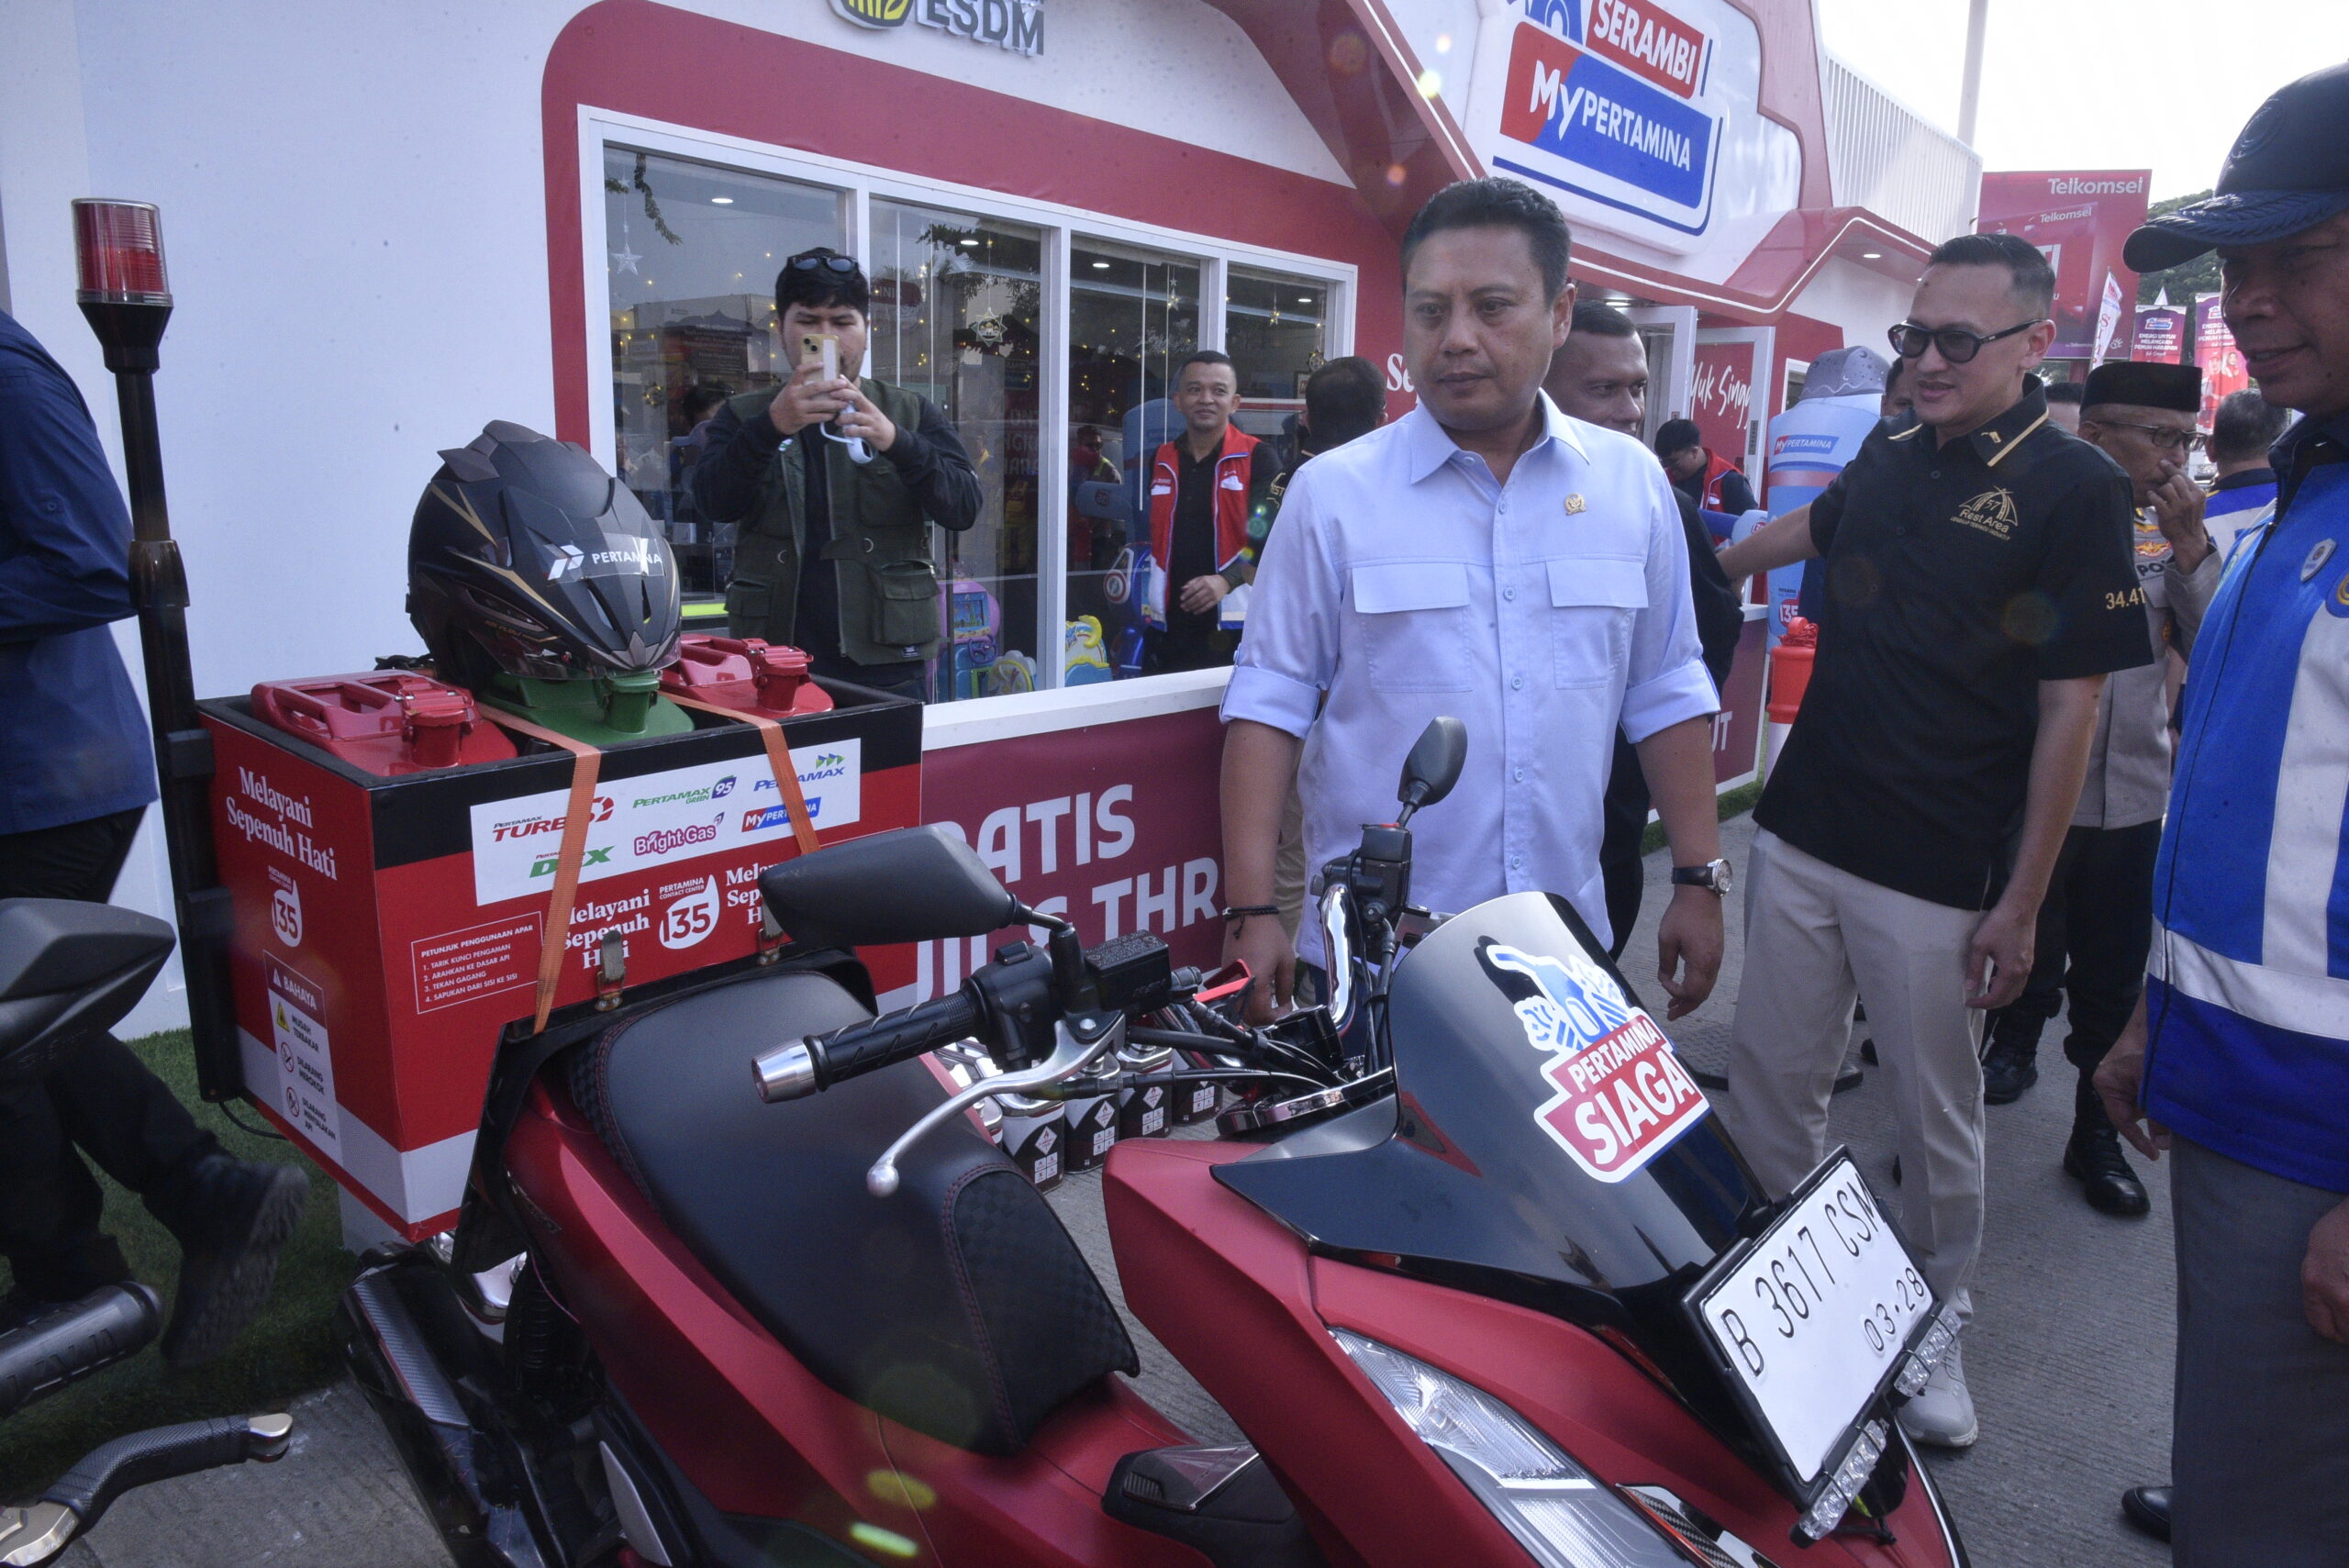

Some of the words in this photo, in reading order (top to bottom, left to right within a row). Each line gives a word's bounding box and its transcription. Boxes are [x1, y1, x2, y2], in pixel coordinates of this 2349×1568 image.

[927, 0, 1044, 55] ESDM
[1594, 0, 1698, 84] SERAMBI
[2048, 177, 2143, 195] Telkomsel
[2041, 207, 2092, 223] Telkomsel
[1959, 508, 1984, 523] Rest
[1983, 516, 2010, 534] Area
[239, 765, 314, 829] Melayani
[632, 786, 711, 808] PERTAMAX
[685, 794, 710, 805] GREEN
[715, 780, 734, 795] 95
[494, 816, 543, 828] PERTAMAX
[226, 795, 295, 858] Sepenuh
[296, 831, 338, 881] Hati
[635, 828, 685, 855] Bright
[685, 824, 717, 843] Gas
[529, 845, 616, 879] DX
[659, 877, 705, 895] PERTAMINA
[659, 888, 685, 901] CONTACT
[685, 884, 705, 895] CENTER
[1092, 857, 1219, 941] THR
[662, 902, 711, 943] 135
[421, 943, 459, 958] PETUNJUK
[460, 929, 513, 948] PENGGUNAAN
[514, 924, 534, 935] APAR
[431, 959, 450, 969] TARIK
[451, 952, 472, 963] KUNCI
[473, 943, 511, 958] PENGAMAN
[582, 940, 630, 970] Hi
[431, 965, 465, 980] ARAHKAN
[466, 961, 475, 971] KE
[476, 957, 498, 968] DASAR
[499, 953, 510, 962] API
[432, 978, 455, 990] TEKAN
[455, 971, 487, 984] GAGANG
[284, 975, 317, 1010] BAHAYA
[433, 987, 466, 1001] SAPUKAN
[466, 982, 483, 992] DARI
[484, 979, 495, 988] SISI
[496, 975, 506, 984] KE
[506, 973, 518, 982] SISI
[1567, 1018, 1661, 1093] PERTAMINA
[1575, 1050, 1696, 1165] SIAGA
[1720, 1308, 1765, 1377] B
[1754, 1225, 1836, 1339] 3617
